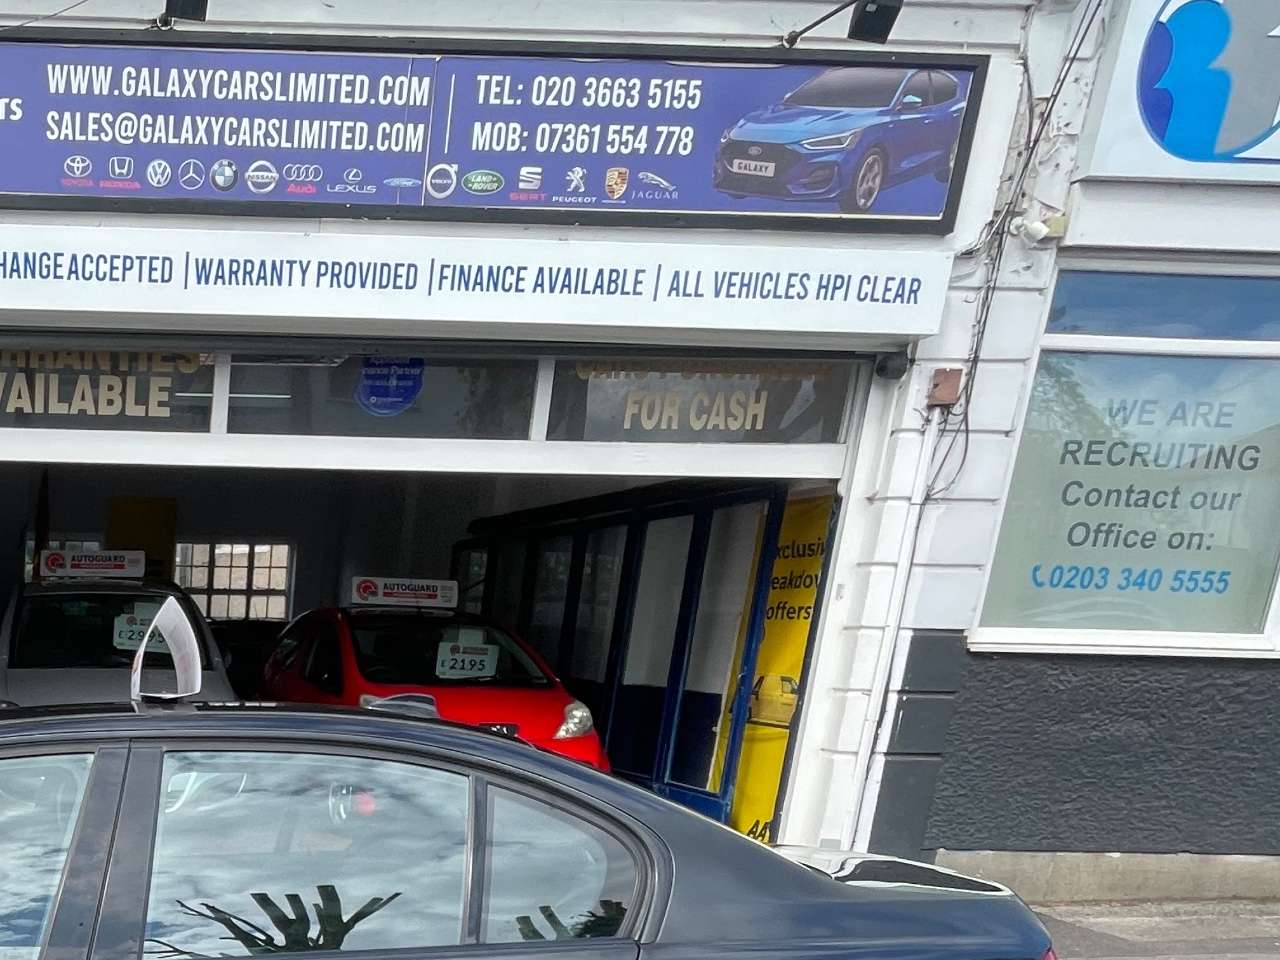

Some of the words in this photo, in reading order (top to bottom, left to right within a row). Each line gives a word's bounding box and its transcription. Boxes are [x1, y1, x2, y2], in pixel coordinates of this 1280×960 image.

[47, 63, 430, 107] WWW.GALAXYCARSLIMITED.COM
[476, 75, 523, 106] TEL:
[532, 76, 576, 107] 020
[582, 77, 639, 109] 3663
[647, 79, 702, 111] 5155
[46, 110, 425, 153] SALES@GALAXYCARSLIMITED.COM
[472, 122, 529, 154] MOB:
[535, 123, 600, 155] 07361
[606, 124, 647, 156] 554
[654, 126, 694, 157] 778
[245, 173, 277, 182] NISSAN
[737, 162, 769, 174] GALAXY
[287, 183, 317, 195] Audi
[326, 183, 377, 194] LEXUS
[552, 195, 597, 204] PEUGEOT
[631, 190, 680, 200] JAGUAR
[67, 253, 173, 284] ACCEPTED
[195, 257, 312, 289] WARRANTY
[316, 260, 418, 291] PROVIDED
[438, 263, 528, 294] FINANCE
[532, 265, 646, 297] AVAILABLE
[668, 269, 705, 299] ALL
[714, 270, 811, 302] VEHICLES
[816, 273, 850, 303] HPI
[857, 274, 922, 306] CLEAR
[623, 390, 680, 431] FOR
[689, 389, 768, 431] CASH
[1107, 399, 1160, 427] WE
[1166, 401, 1238, 429] ARE
[1059, 439, 1262, 471] RECRUITING
[1061, 480, 1181, 510] Contact
[1190, 491, 1242, 511] our
[776, 536, 825, 559] xclusi
[1067, 521, 1157, 549] Office
[1167, 531, 1216, 551] on:
[70, 554, 126, 564] AUTOGUARD
[383, 582, 439, 593] AUTOGUARD
[1049, 564, 1110, 590] 0203
[1117, 567, 1164, 592] 340
[1170, 569, 1232, 594] 5555
[767, 601, 812, 620] offers
